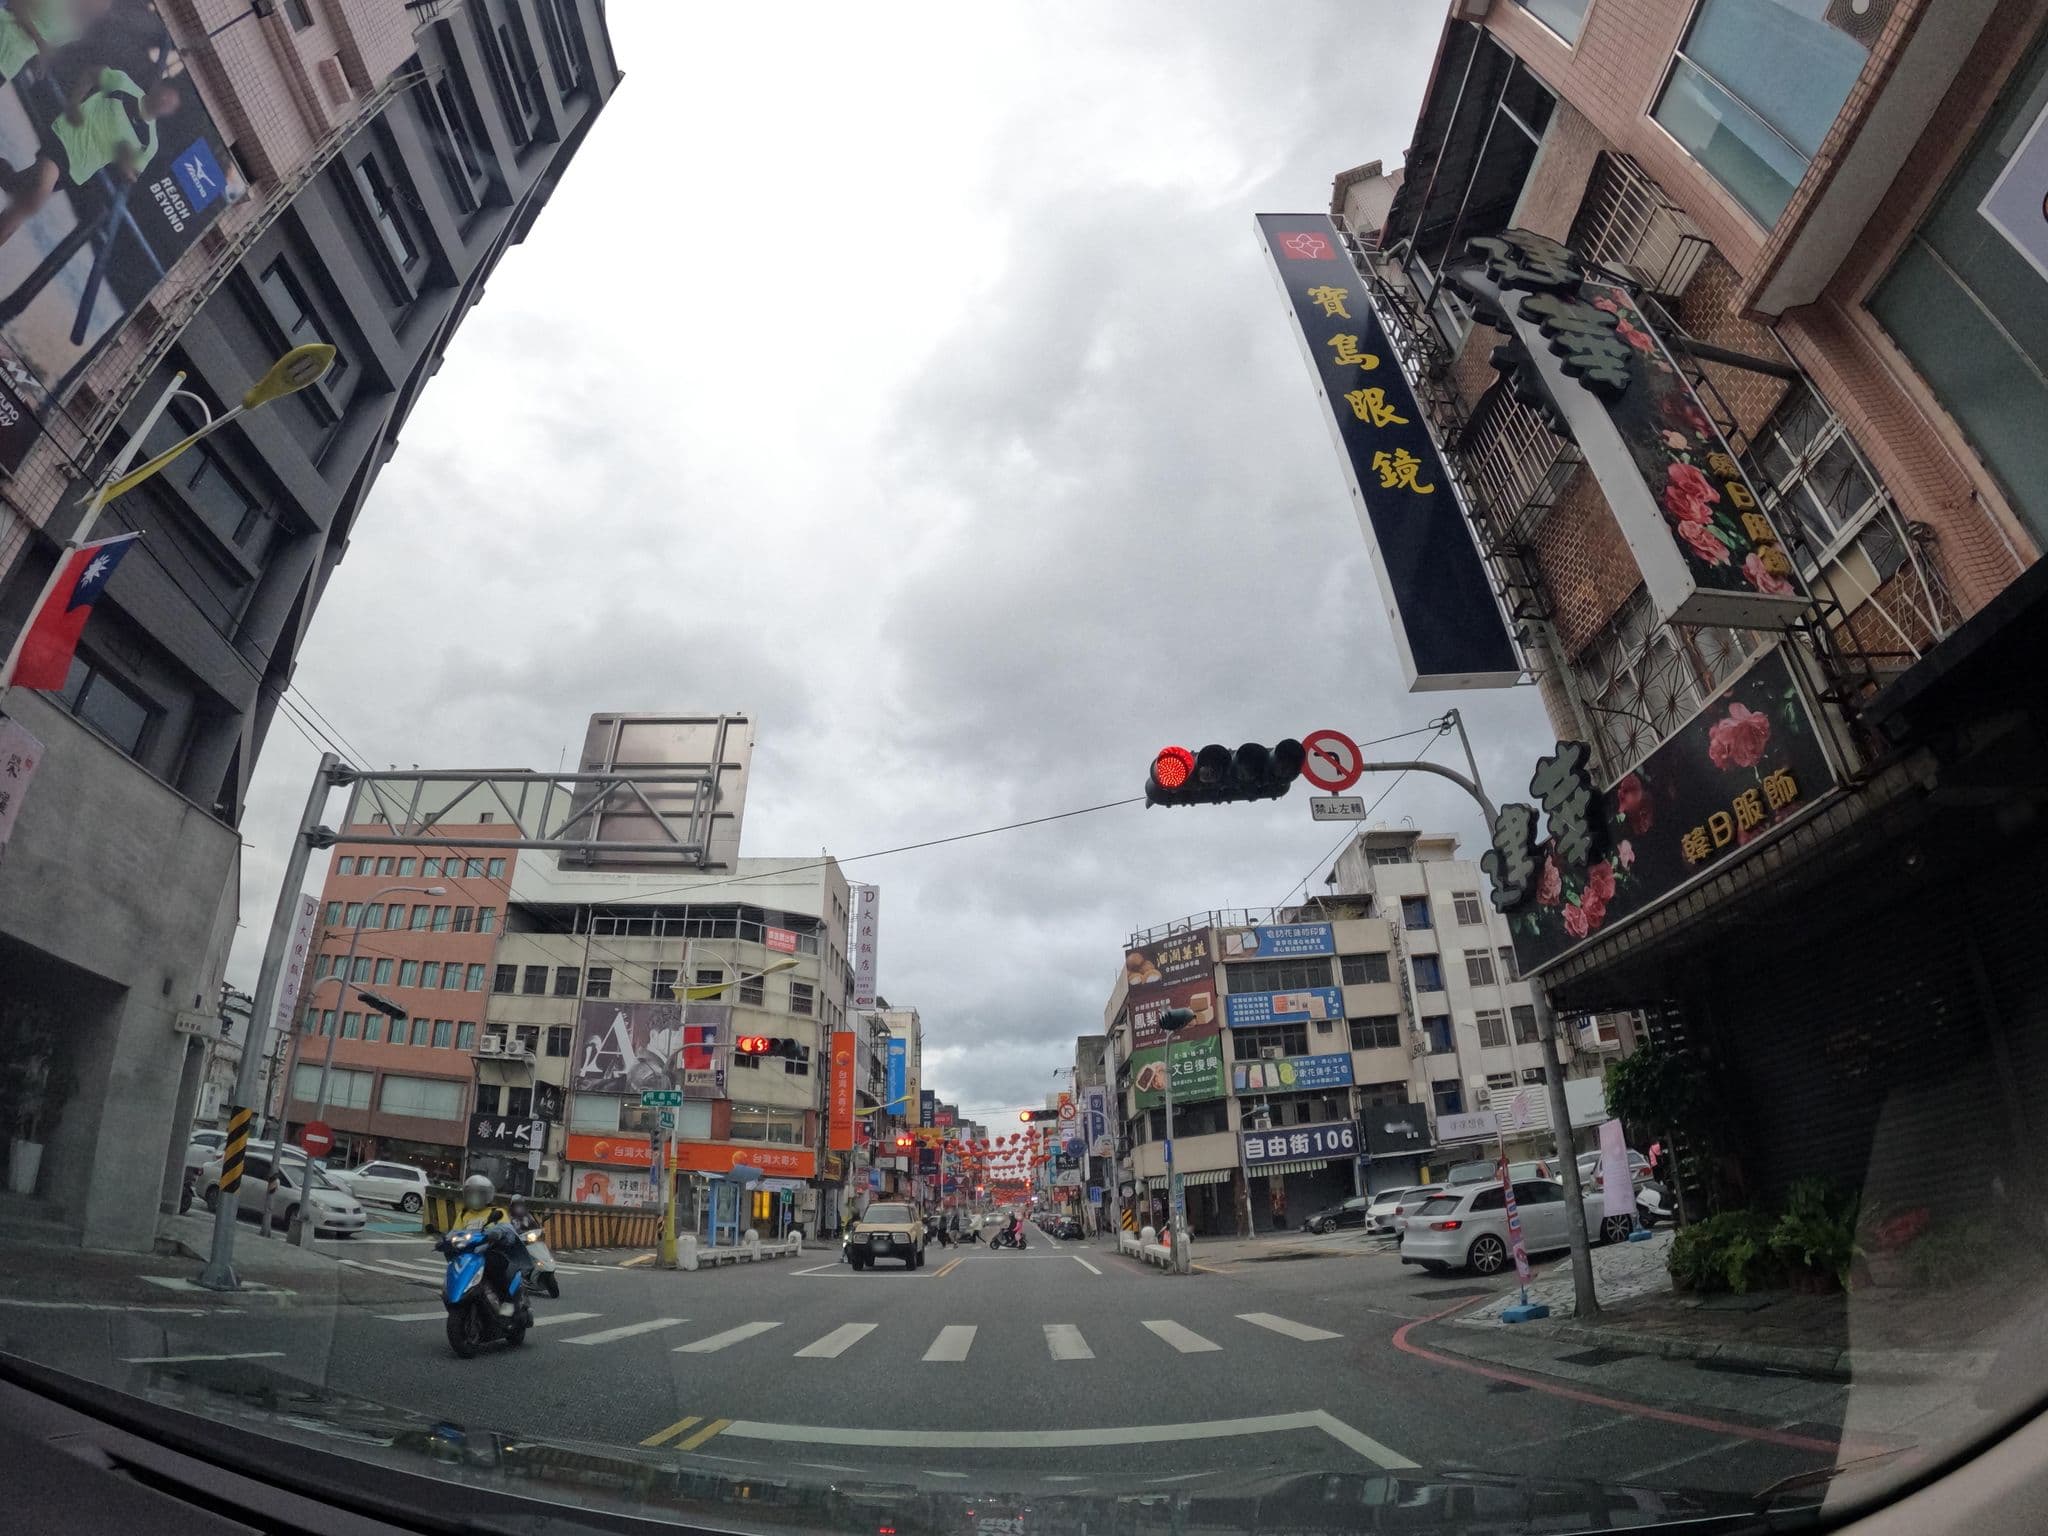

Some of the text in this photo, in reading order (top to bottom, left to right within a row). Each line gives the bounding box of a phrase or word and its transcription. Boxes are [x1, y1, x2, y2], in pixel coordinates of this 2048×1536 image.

[149, 182, 185, 233] BEYOND
[160, 176, 191, 220] REACH
[1315, 802, 1362, 815] 禁止左轉
[1171, 1056, 1218, 1077] 文旦復興
[1245, 1128, 1354, 1160] 自由街106
[752, 1152, 799, 1168] 台灣大哥大
